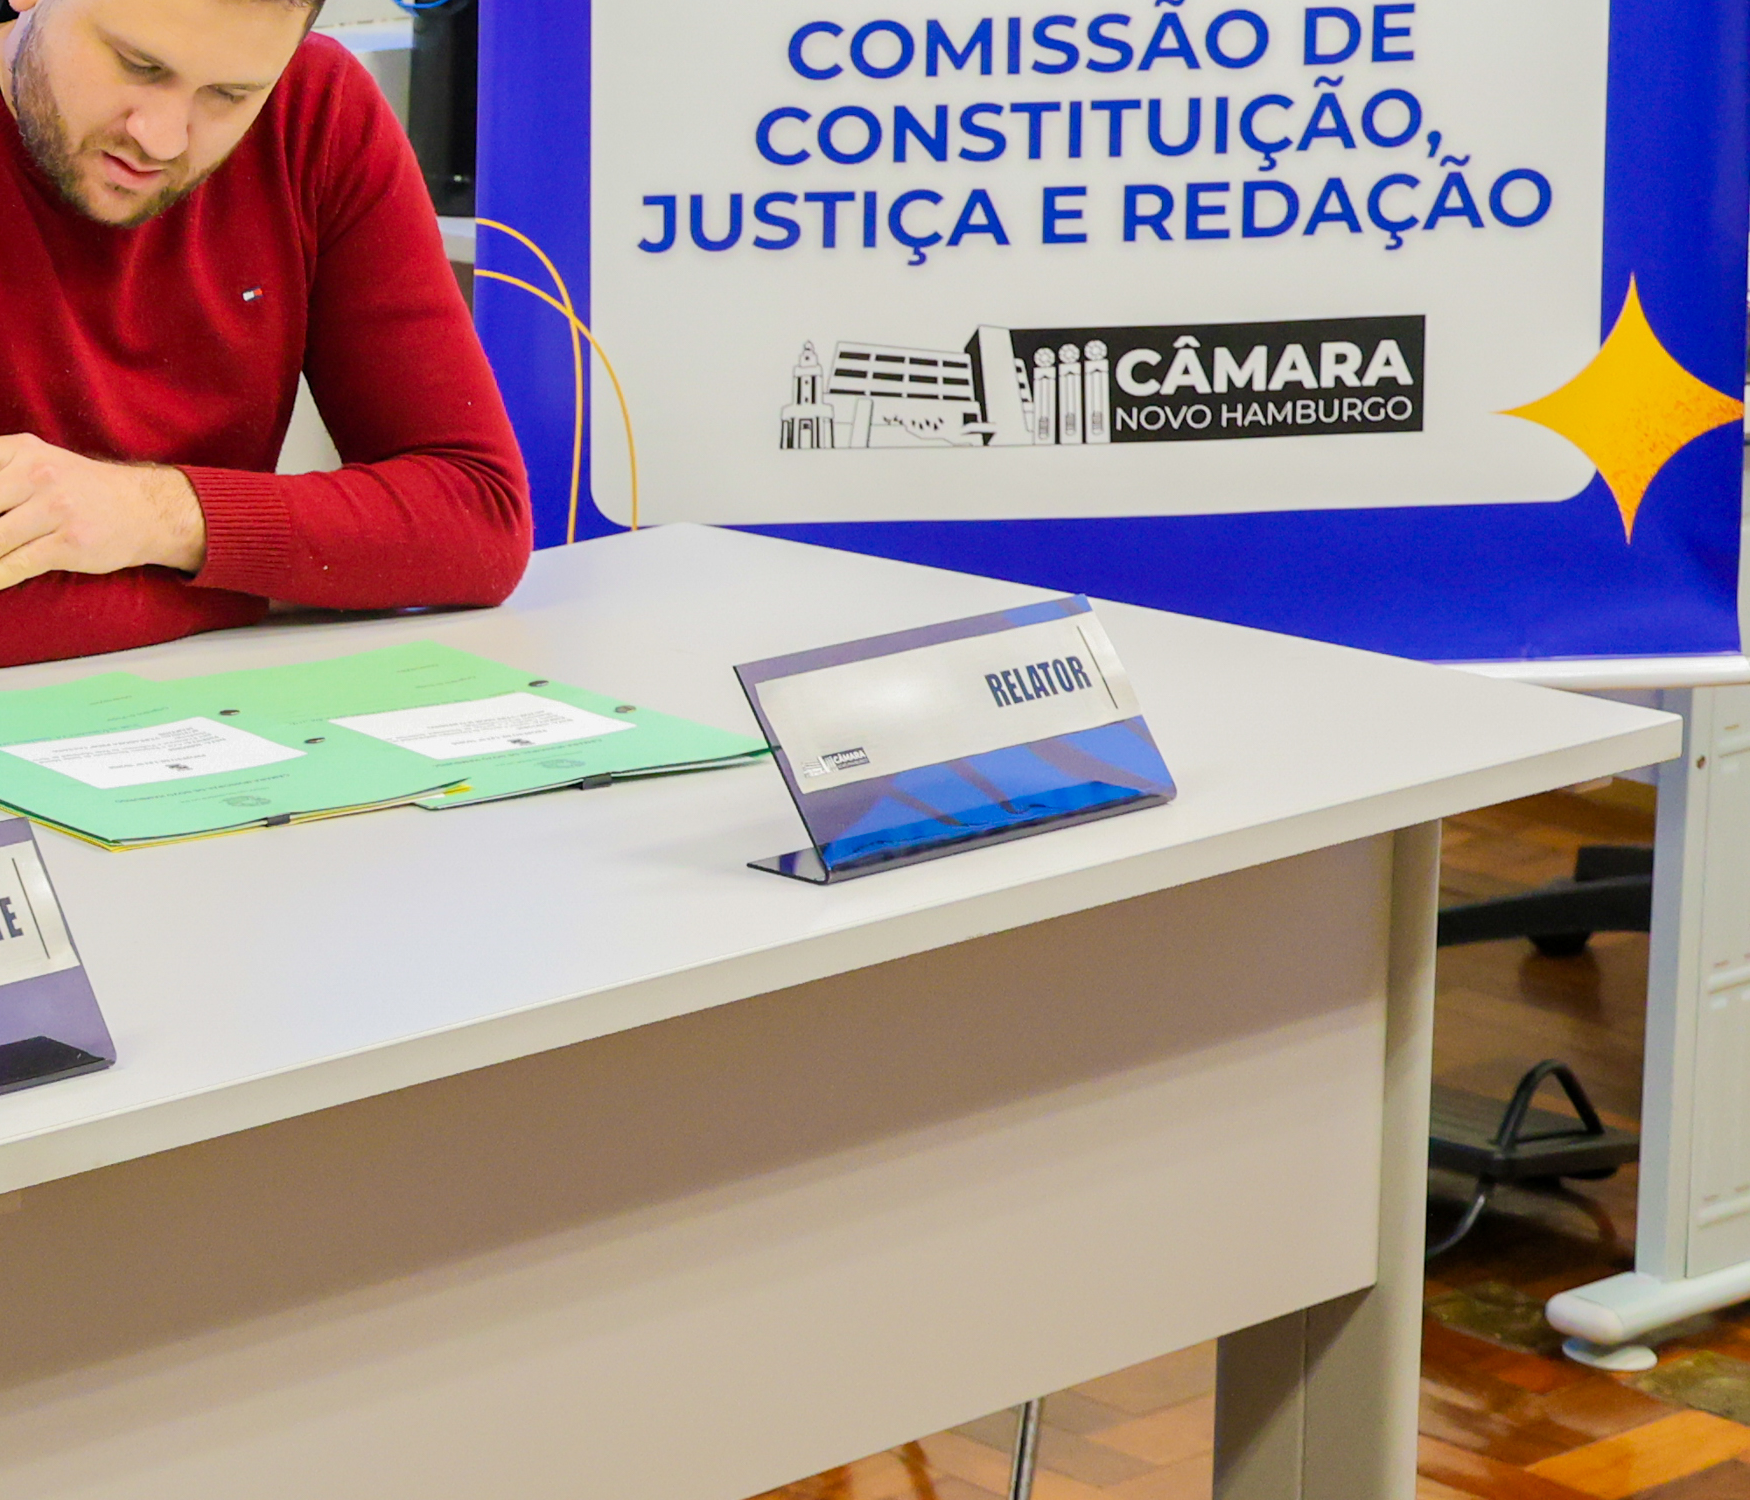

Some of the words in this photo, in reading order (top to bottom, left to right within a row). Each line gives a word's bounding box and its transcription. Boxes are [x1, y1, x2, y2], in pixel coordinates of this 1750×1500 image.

[1302, 2, 1417, 67] DE
[754, 74, 1445, 172] CONSTITUIÇÃO,
[636, 185, 1011, 266] JUSTIÇA
[1041, 185, 1089, 246] E
[1121, 154, 1553, 250] REDAÇÃO
[1114, 334, 1415, 398] CÂMARA
[1114, 403, 1213, 432] NOVO
[1220, 395, 1414, 429] HAMBURGO
[983, 655, 1093, 708] RELATOR
